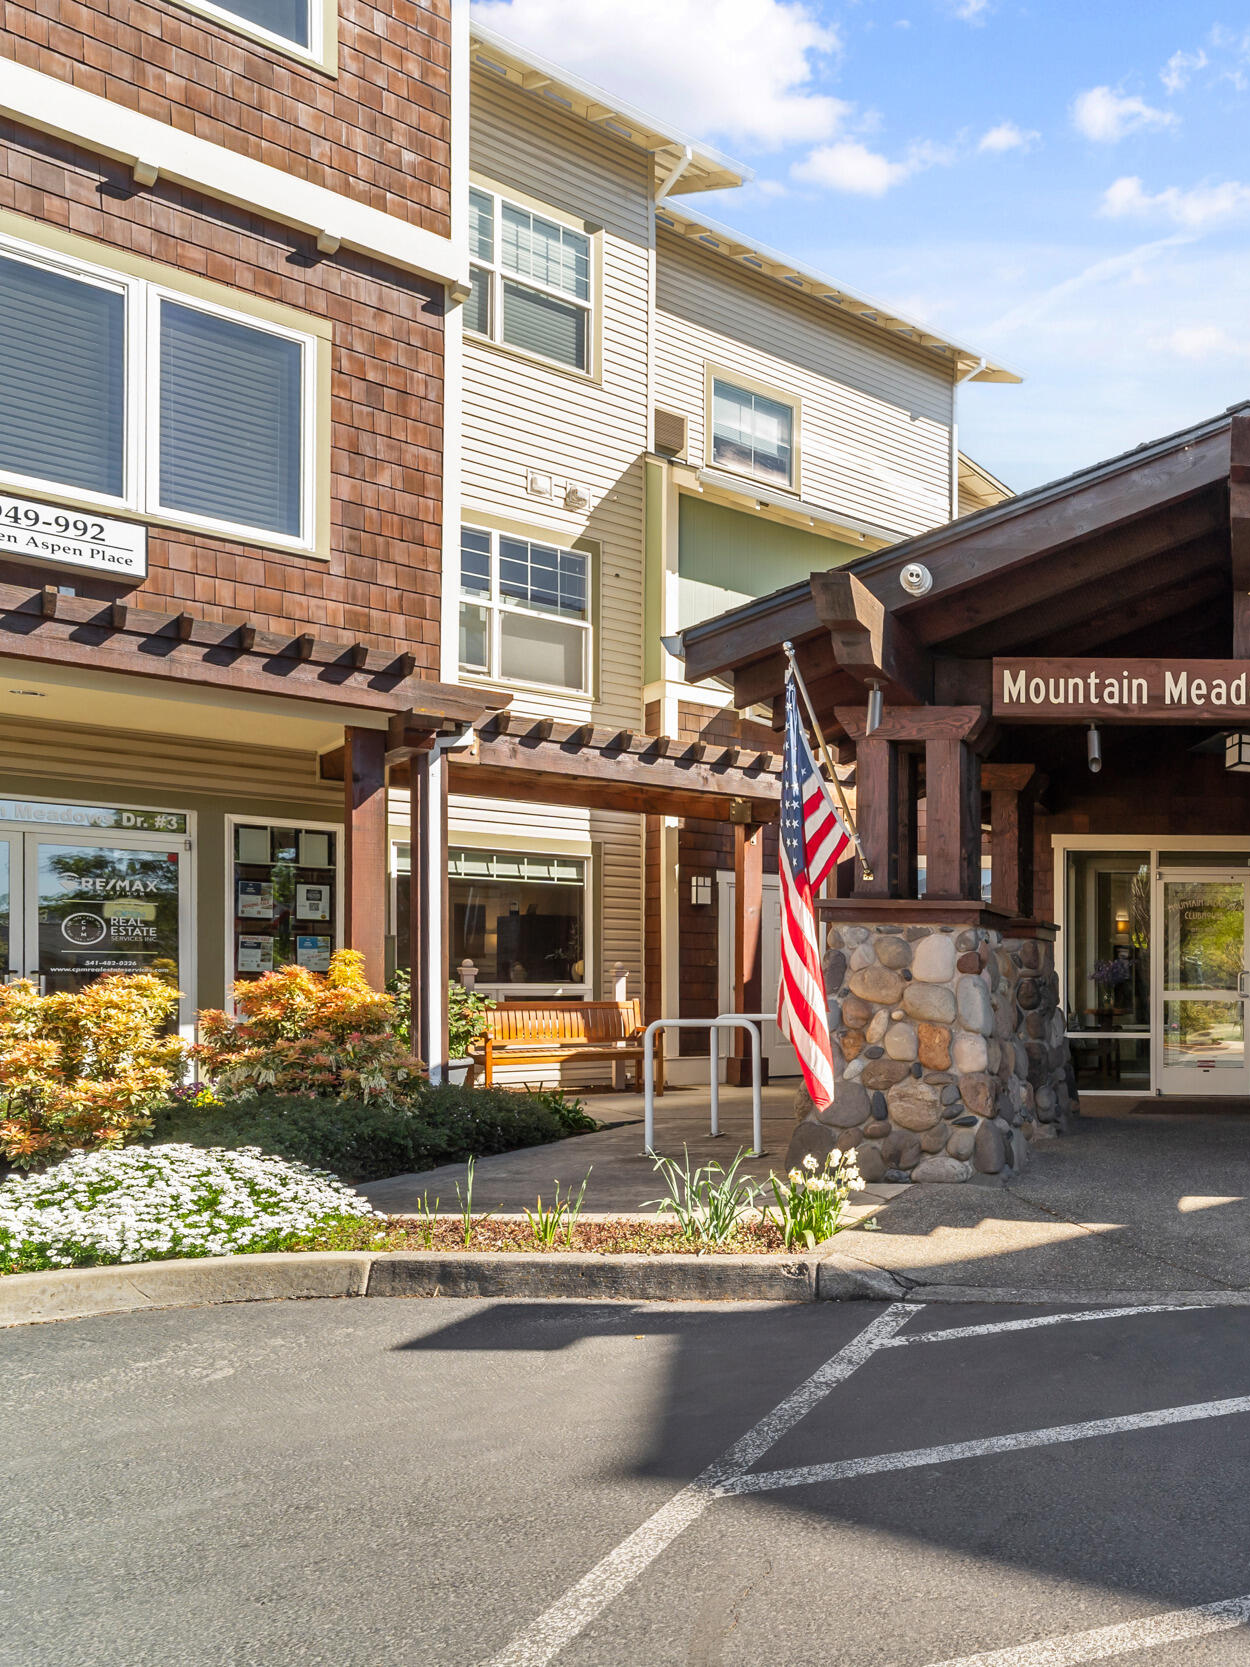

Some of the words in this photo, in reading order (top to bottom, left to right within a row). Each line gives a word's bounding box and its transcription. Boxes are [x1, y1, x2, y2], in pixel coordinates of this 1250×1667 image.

[0, 504, 106, 542] 49-992
[25, 536, 83, 557] Aspen
[89, 548, 134, 567] Place
[1003, 669, 1149, 704] Mountain
[14, 803, 115, 825] Meadows
[122, 812, 148, 828] Dr.
[154, 815, 178, 830] #3
[80, 877, 158, 893] RE/MAX
[110, 916, 145, 926] REAL
[110, 926, 158, 937] ESTATE
